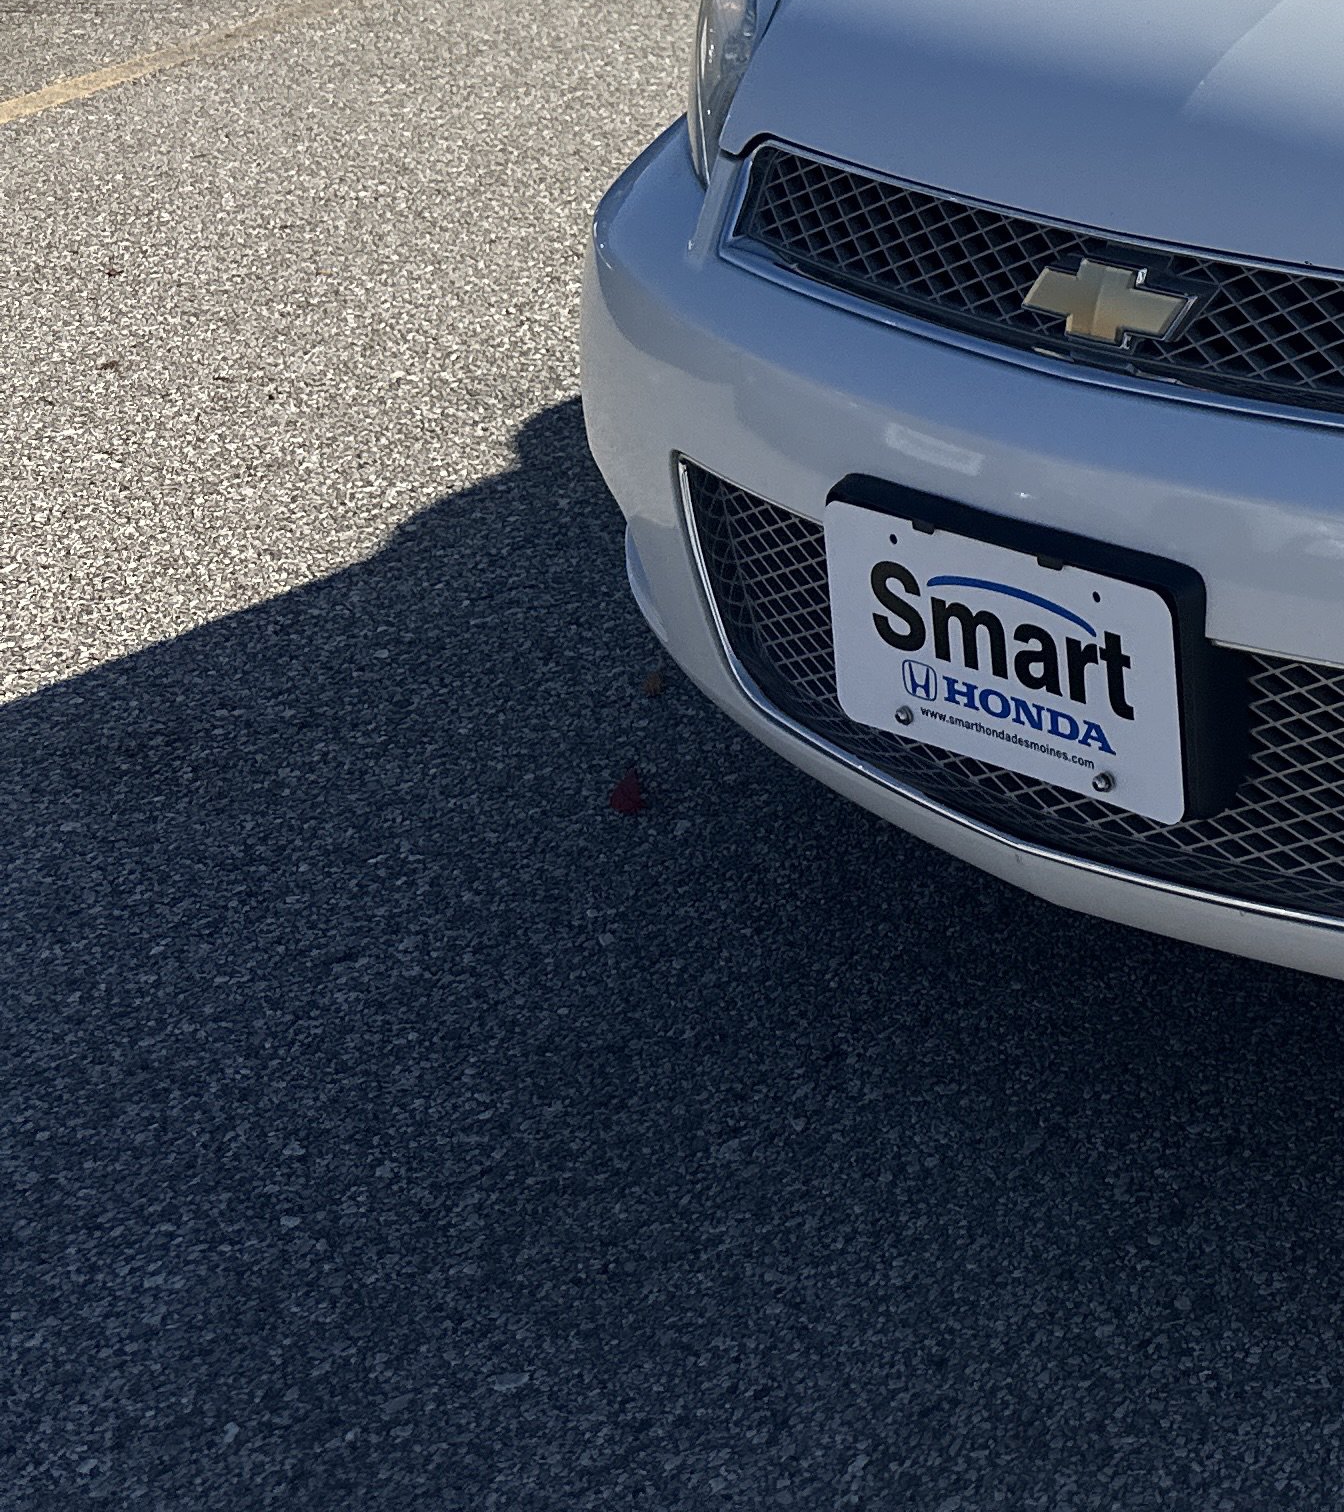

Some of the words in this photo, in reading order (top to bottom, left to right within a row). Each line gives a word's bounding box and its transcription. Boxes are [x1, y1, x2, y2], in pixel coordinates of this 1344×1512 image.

[870, 560, 1135, 721] Smart
[920, 706, 1096, 770] www.smarthondadesmoines.com
[942, 675, 1117, 756] HONDA
